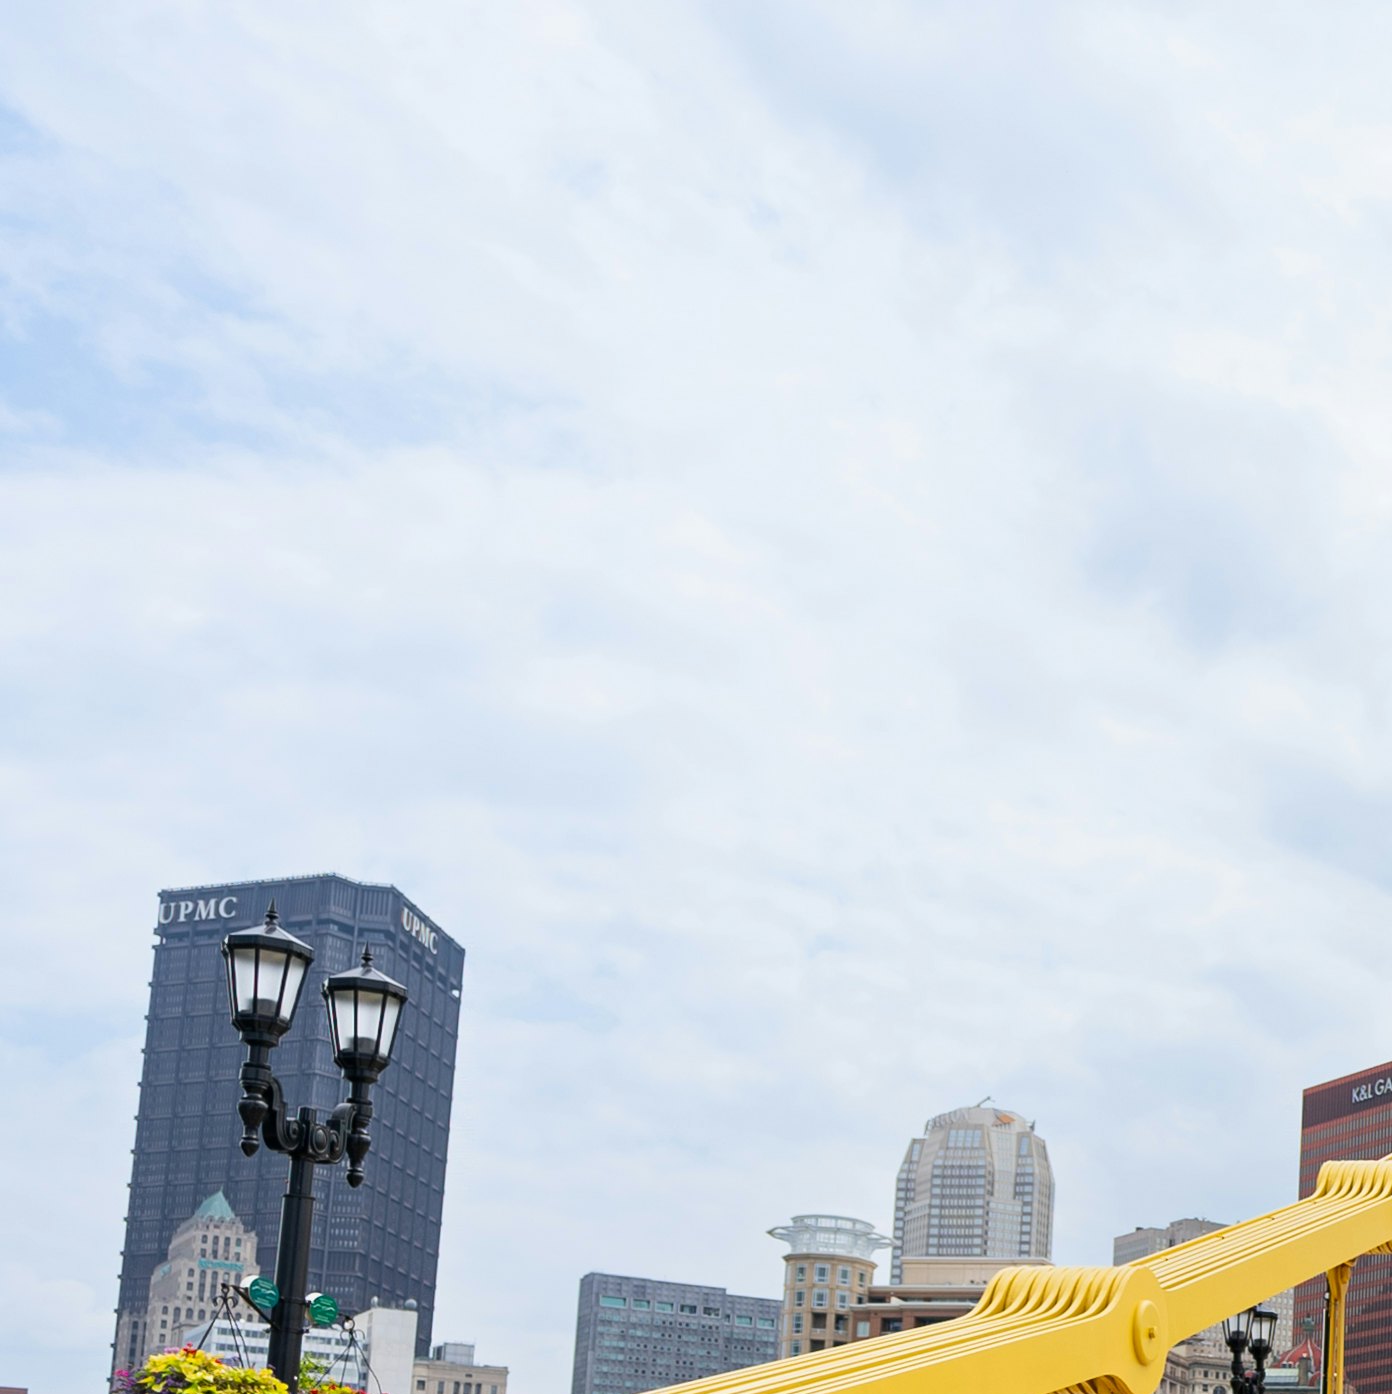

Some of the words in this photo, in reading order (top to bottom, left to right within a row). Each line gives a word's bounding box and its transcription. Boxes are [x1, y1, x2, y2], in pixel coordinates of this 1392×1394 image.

[159, 896, 237, 924] UPMC
[402, 907, 439, 955] UPMC
[1352, 1084, 1373, 1104] K&L
